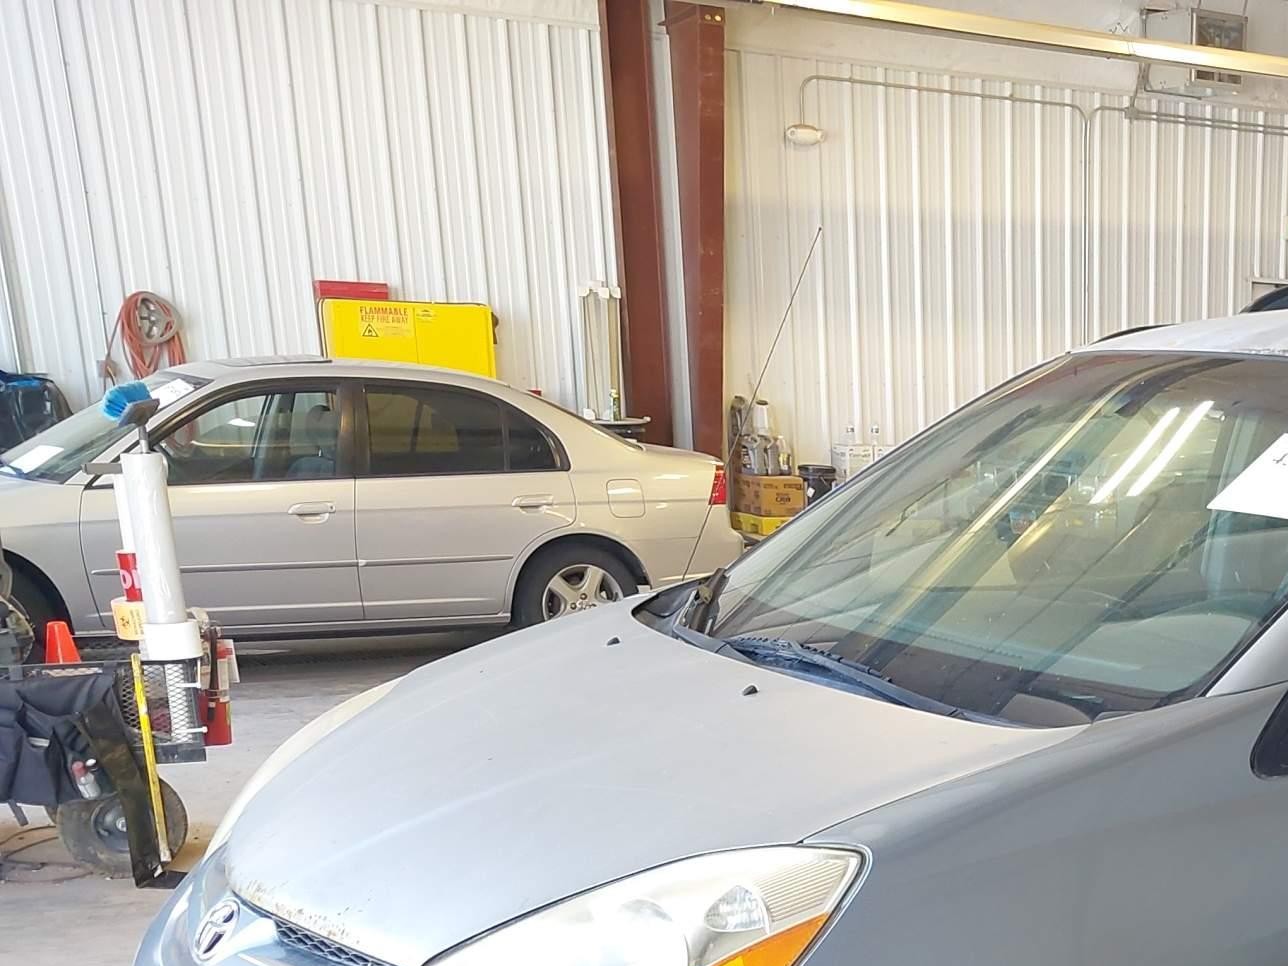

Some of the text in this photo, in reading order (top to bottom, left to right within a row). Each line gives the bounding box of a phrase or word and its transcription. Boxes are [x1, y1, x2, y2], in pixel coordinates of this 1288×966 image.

[360, 306, 408, 317] FLAMMABLE
[361, 314, 408, 324] KEEP FIRE AWAY
